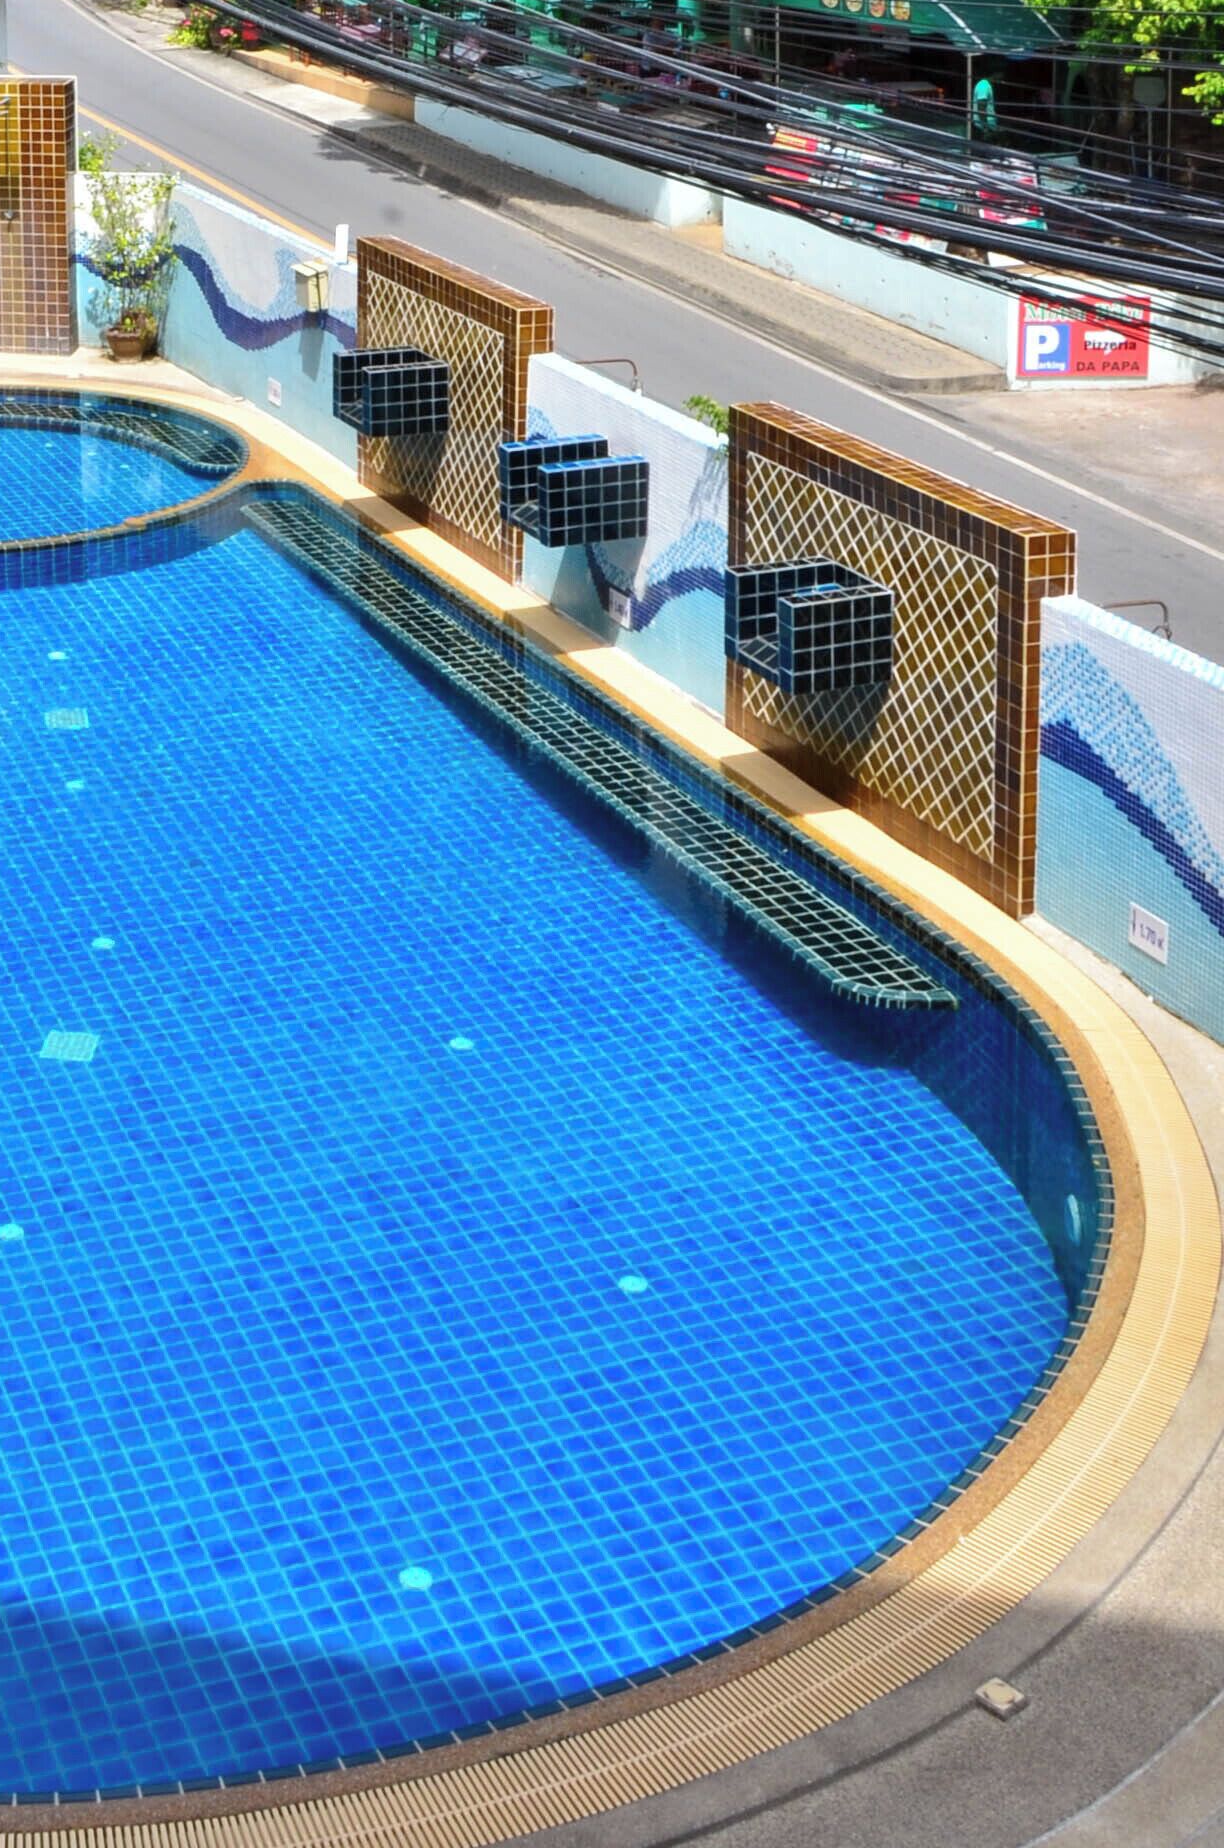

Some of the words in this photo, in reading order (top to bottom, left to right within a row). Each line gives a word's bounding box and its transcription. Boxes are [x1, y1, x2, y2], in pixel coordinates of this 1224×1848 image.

[1083, 340, 1137, 351] Pizzeria
[1076, 361, 1096, 372] DA
[1102, 361, 1141, 372] PAPA
